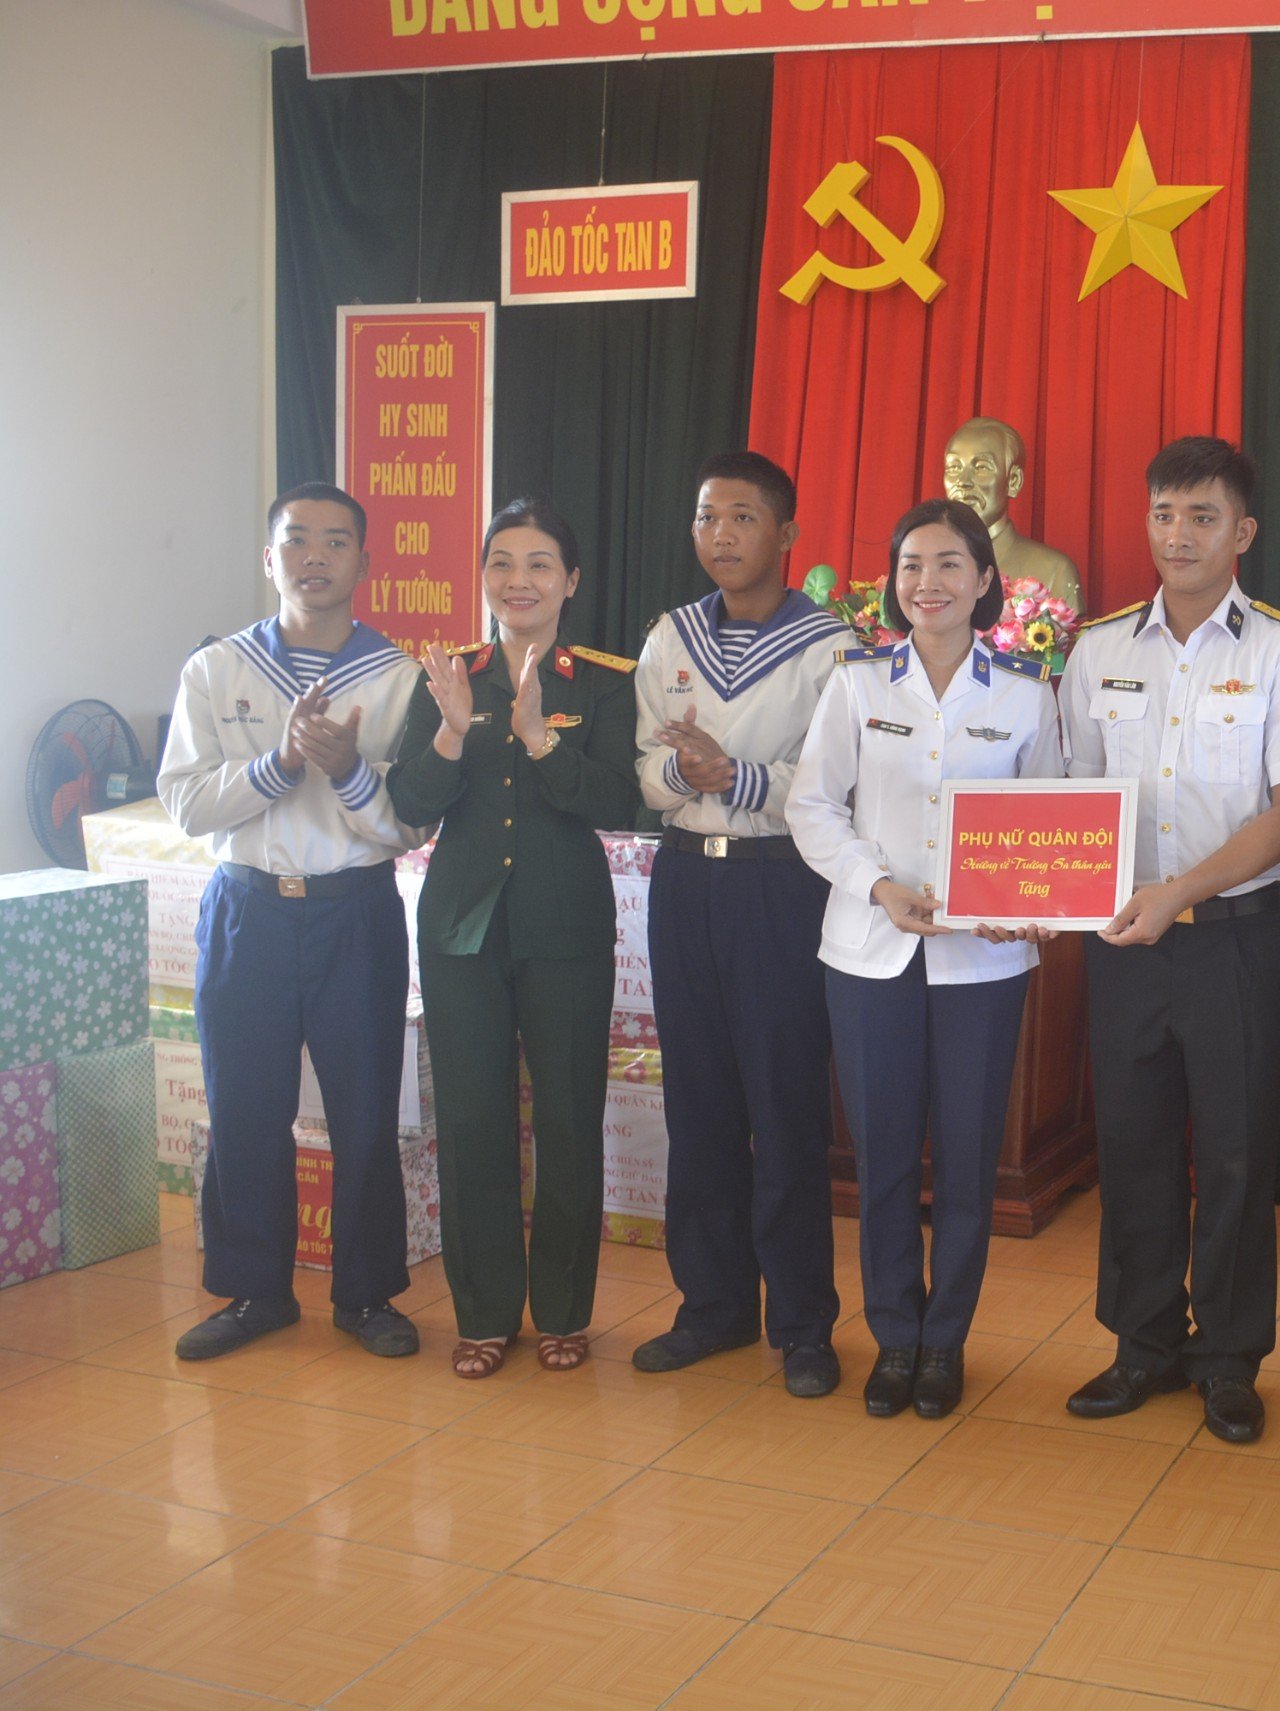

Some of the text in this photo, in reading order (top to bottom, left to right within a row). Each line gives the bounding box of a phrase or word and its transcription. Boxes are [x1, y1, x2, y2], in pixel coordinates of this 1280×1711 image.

[525, 205, 672, 278] ĐẢO TỐC TAN B
[375, 331, 454, 379] SUỐT ĐỜI
[379, 403, 449, 438] HY SINH
[368, 450, 457, 498] PHẤN ĐẤU
[394, 521, 430, 556] CHO
[370, 568, 452, 615] LÝ TƯỞNG
[958, 827, 1113, 849] PHỤ NỮ QUÂN ĐỘI
[1018, 880, 1051, 898] Tặng
